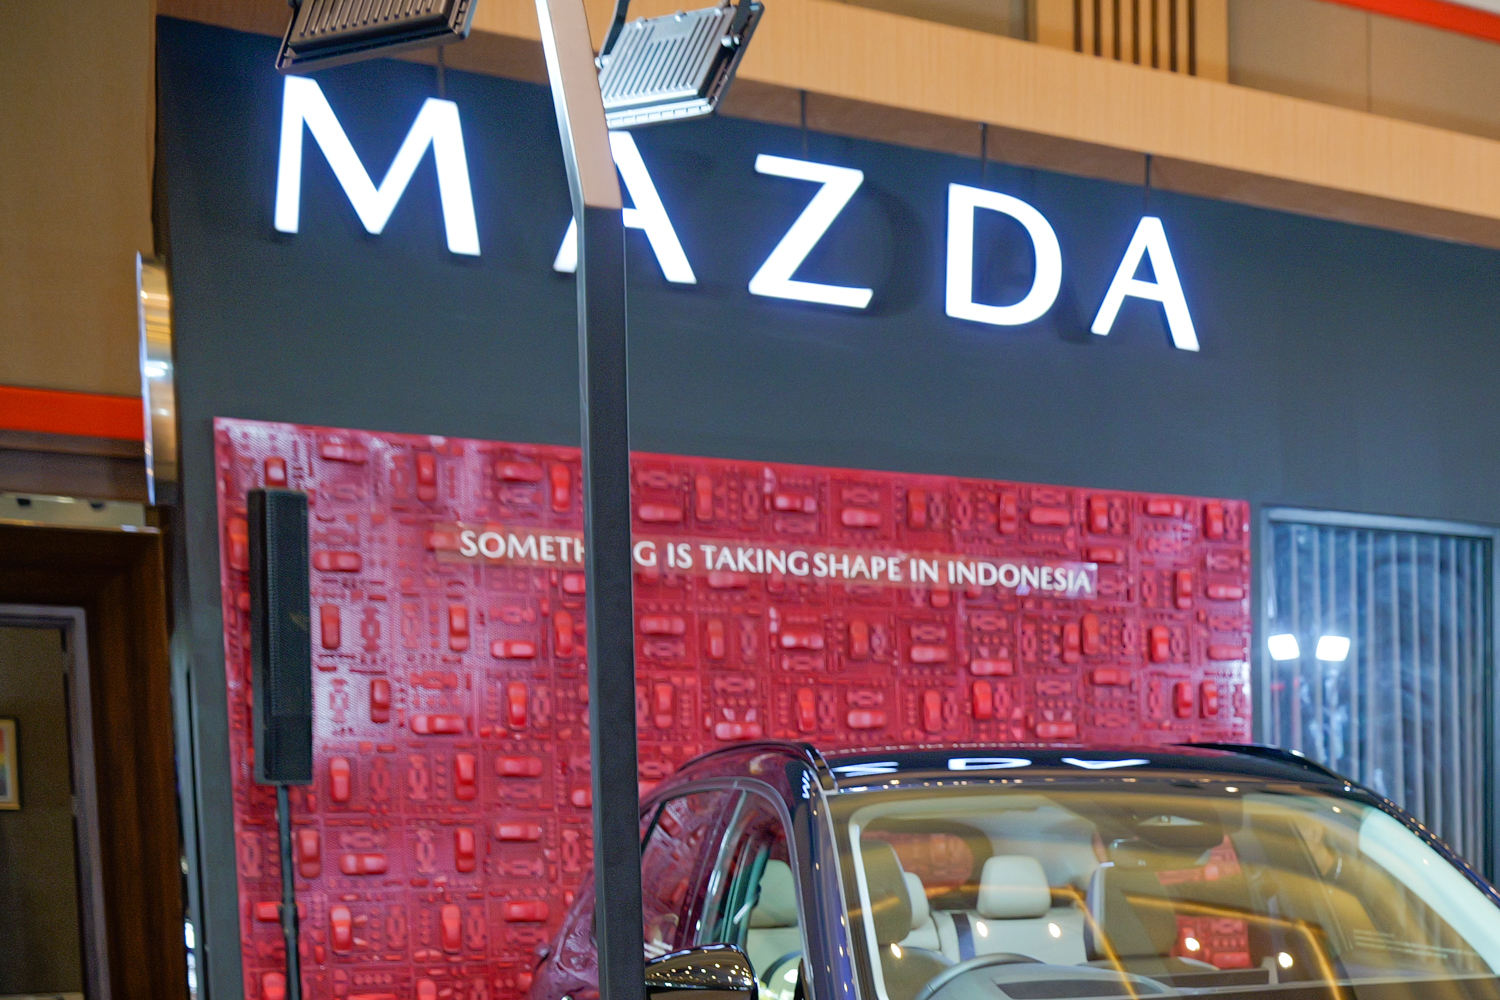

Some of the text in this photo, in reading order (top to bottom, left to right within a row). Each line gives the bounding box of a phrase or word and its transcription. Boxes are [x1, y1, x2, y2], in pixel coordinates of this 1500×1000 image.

[275, 75, 1200, 352] MAZDA
[667, 542, 693, 569] IS
[700, 544, 809, 576] TAKING
[812, 552, 902, 582] SHAPE
[910, 557, 940, 584] IN
[948, 560, 1092, 594] INDONESIA
